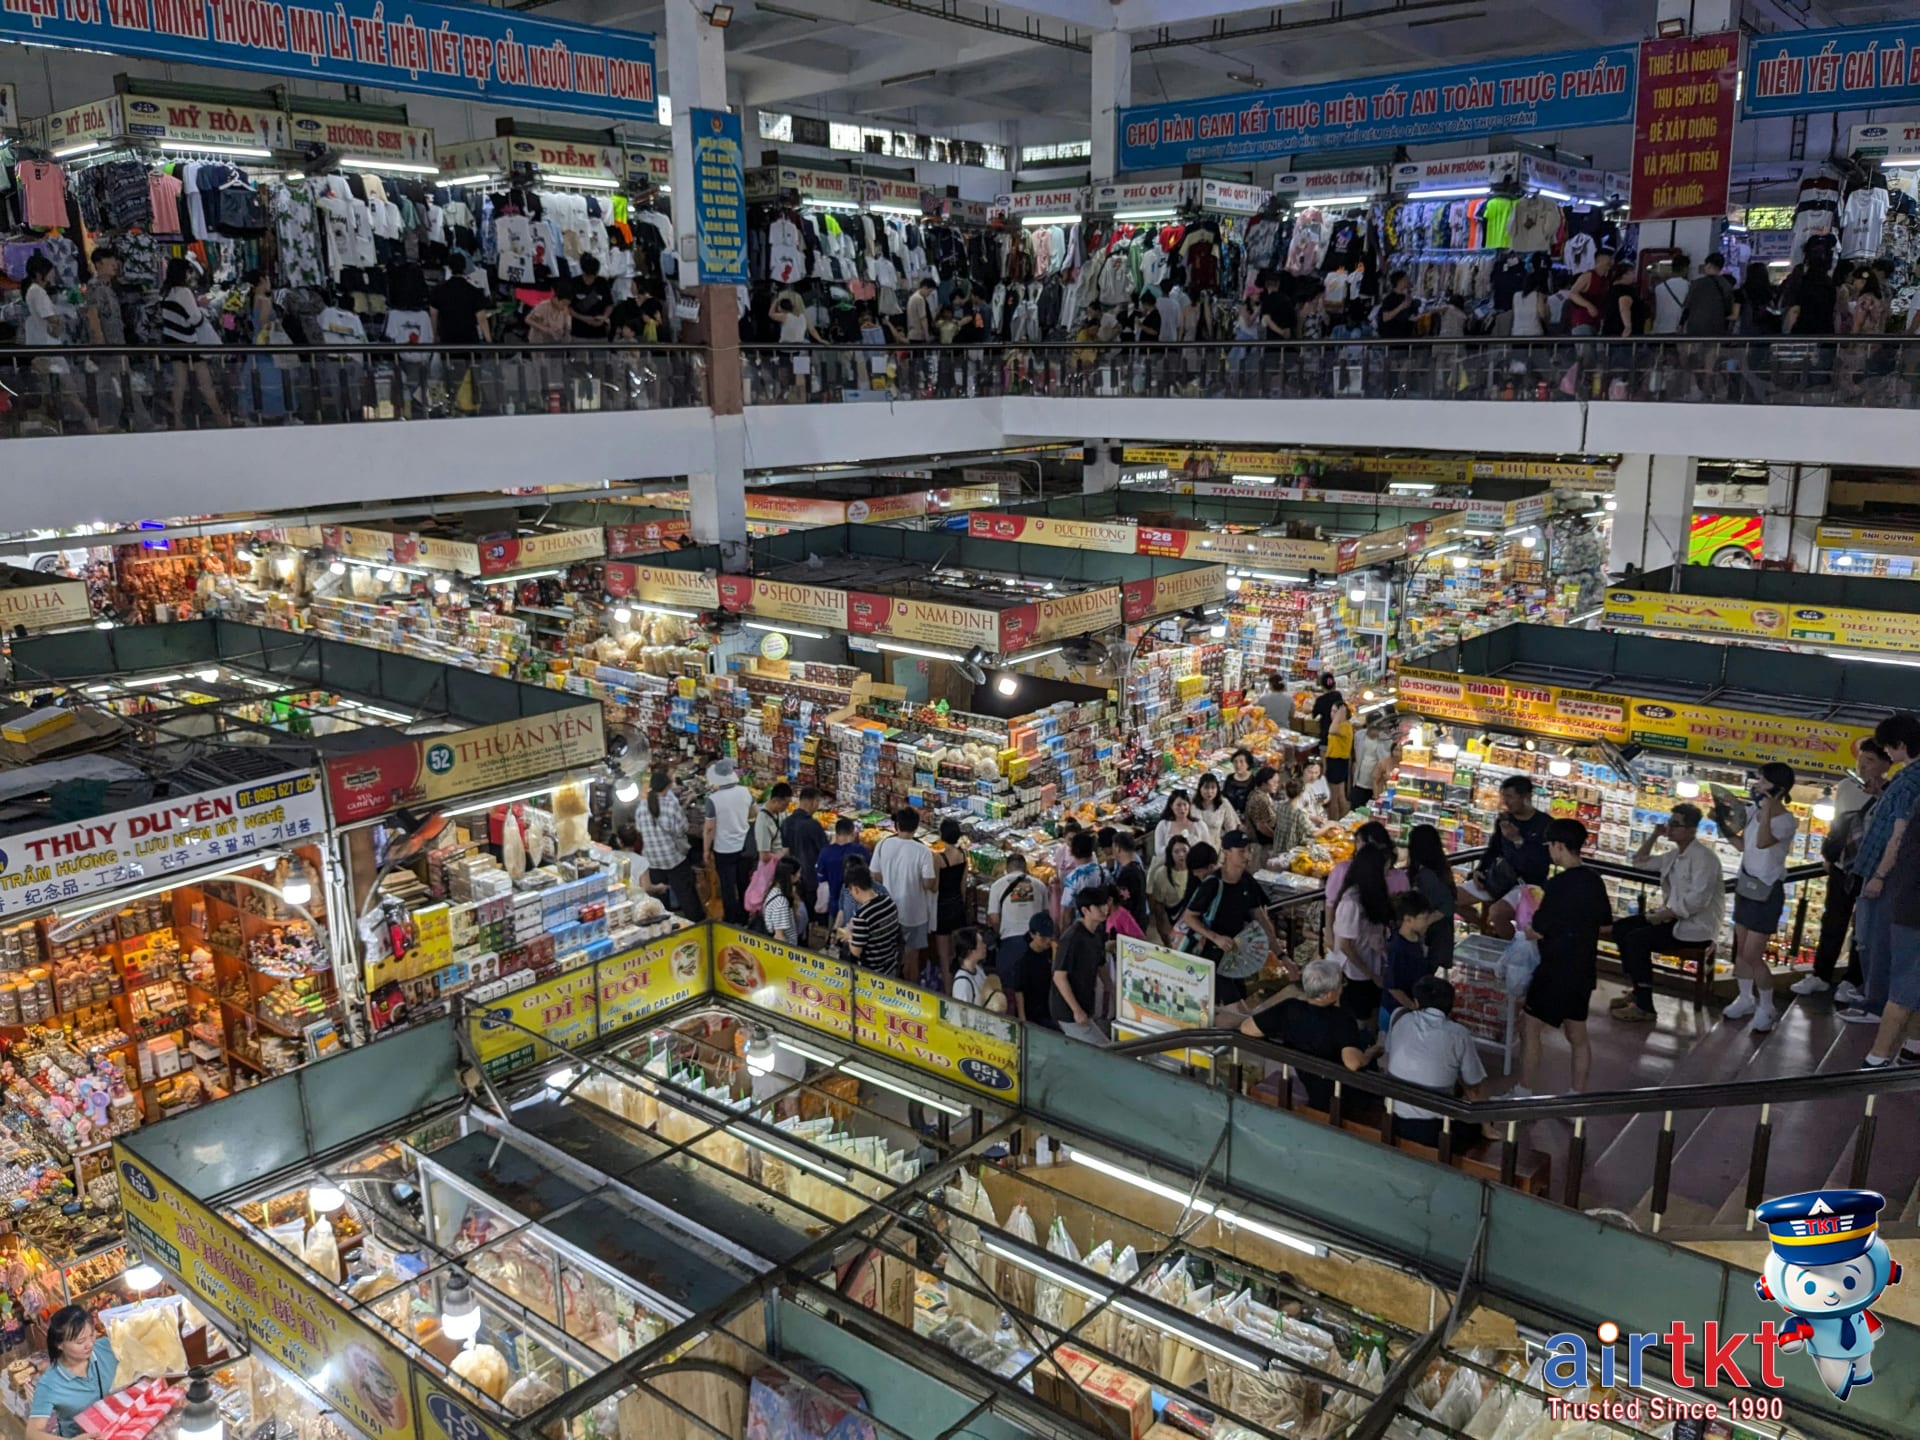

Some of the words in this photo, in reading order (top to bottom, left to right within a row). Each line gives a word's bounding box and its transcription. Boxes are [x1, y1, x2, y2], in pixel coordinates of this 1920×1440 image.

[153, 0, 208, 39] MINH
[288, 6, 327, 66] MẠI
[327, 2, 353, 60] LÀ
[350, 1, 388, 65] THỂ
[389, 15, 428, 80] HIỆN
[430, 21, 460, 77] NÉT
[462, 35, 493, 89] ĐẸP
[496, 29, 529, 86] CỦA
[528, 40, 573, 91] NGƯỜI
[574, 53, 608, 96] KINH
[609, 59, 653, 102] DOANH
[1648, 47, 1673, 76] THUẾ
[1676, 48, 1688, 72] LÀ
[1756, 49, 1802, 97] NIÊM
[1807, 41, 1842, 93] YẾT
[1843, 41, 1879, 90] GIÁ
[1880, 39, 1906, 86] VÀ
[1127, 121, 1158, 148] CHỢ
[1162, 113, 1194, 143] HÀN
[1199, 114, 1234, 139] CAM
[1239, 101, 1268, 134] KẾT
[1274, 100, 1319, 134] THỰC
[1324, 93, 1367, 129] HIỆN
[1372, 85, 1408, 120] TỐT
[1410, 89, 1438, 116] AN
[1444, 77, 1495, 112] TOÀN
[1500, 73, 1556, 107] THỰC
[1561, 56, 1627, 99] PHẨM
[1653, 87, 1673, 109] THU
[1675, 77, 1698, 107] CHỦ
[1699, 77, 1718, 104] YẾU
[166, 105, 201, 128] MỸ
[208, 108, 254, 133] HÒA
[377, 130, 402, 150] SEN
[1644, 151, 1656, 176] VÀ
[1659, 148, 1685, 175] PHÁT
[1688, 142, 1719, 171] TRIỂN
[1035, 193, 1071, 208] HẠNH
[1211, 486, 1257, 497] THANH
[1054, 523, 1077, 537] ĐỨC
[34, 588, 65, 608] HÀ
[770, 586, 811, 604] SHOP
[814, 591, 845, 609] NHI
[1054, 600, 1083, 618] NAM
[915, 605, 948, 625] NAM
[951, 608, 993, 633] ĐỊNH
[1466, 682, 1506, 697] THANH
[430, 748, 450, 769] 52
[549, 713, 593, 742] YẾN
[278, 783, 294, 800] 627
[26, 822, 117, 861] THÙY
[129, 795, 233, 838] DUYÊN
[0, 864, 52, 891] TRẦM
[56, 849, 118, 877] HƯƠNG
[135, 835, 170, 859] LƯU
[25, 878, 79, 906] 纪念品
[522, 988, 551, 1010] GIA
[556, 977, 573, 996] VỊ
[623, 947, 666, 973] PHẨM
[582, 966, 652, 1011] NUÔI
[787, 977, 876, 1024] NUÔI
[896, 986, 921, 1003] TÔM
[887, 1036, 907, 1053] VỊ
[914, 1047, 952, 1069] GIA
[163, 1191, 194, 1220] GIA
[278, 1278, 336, 1331] PHẨM
